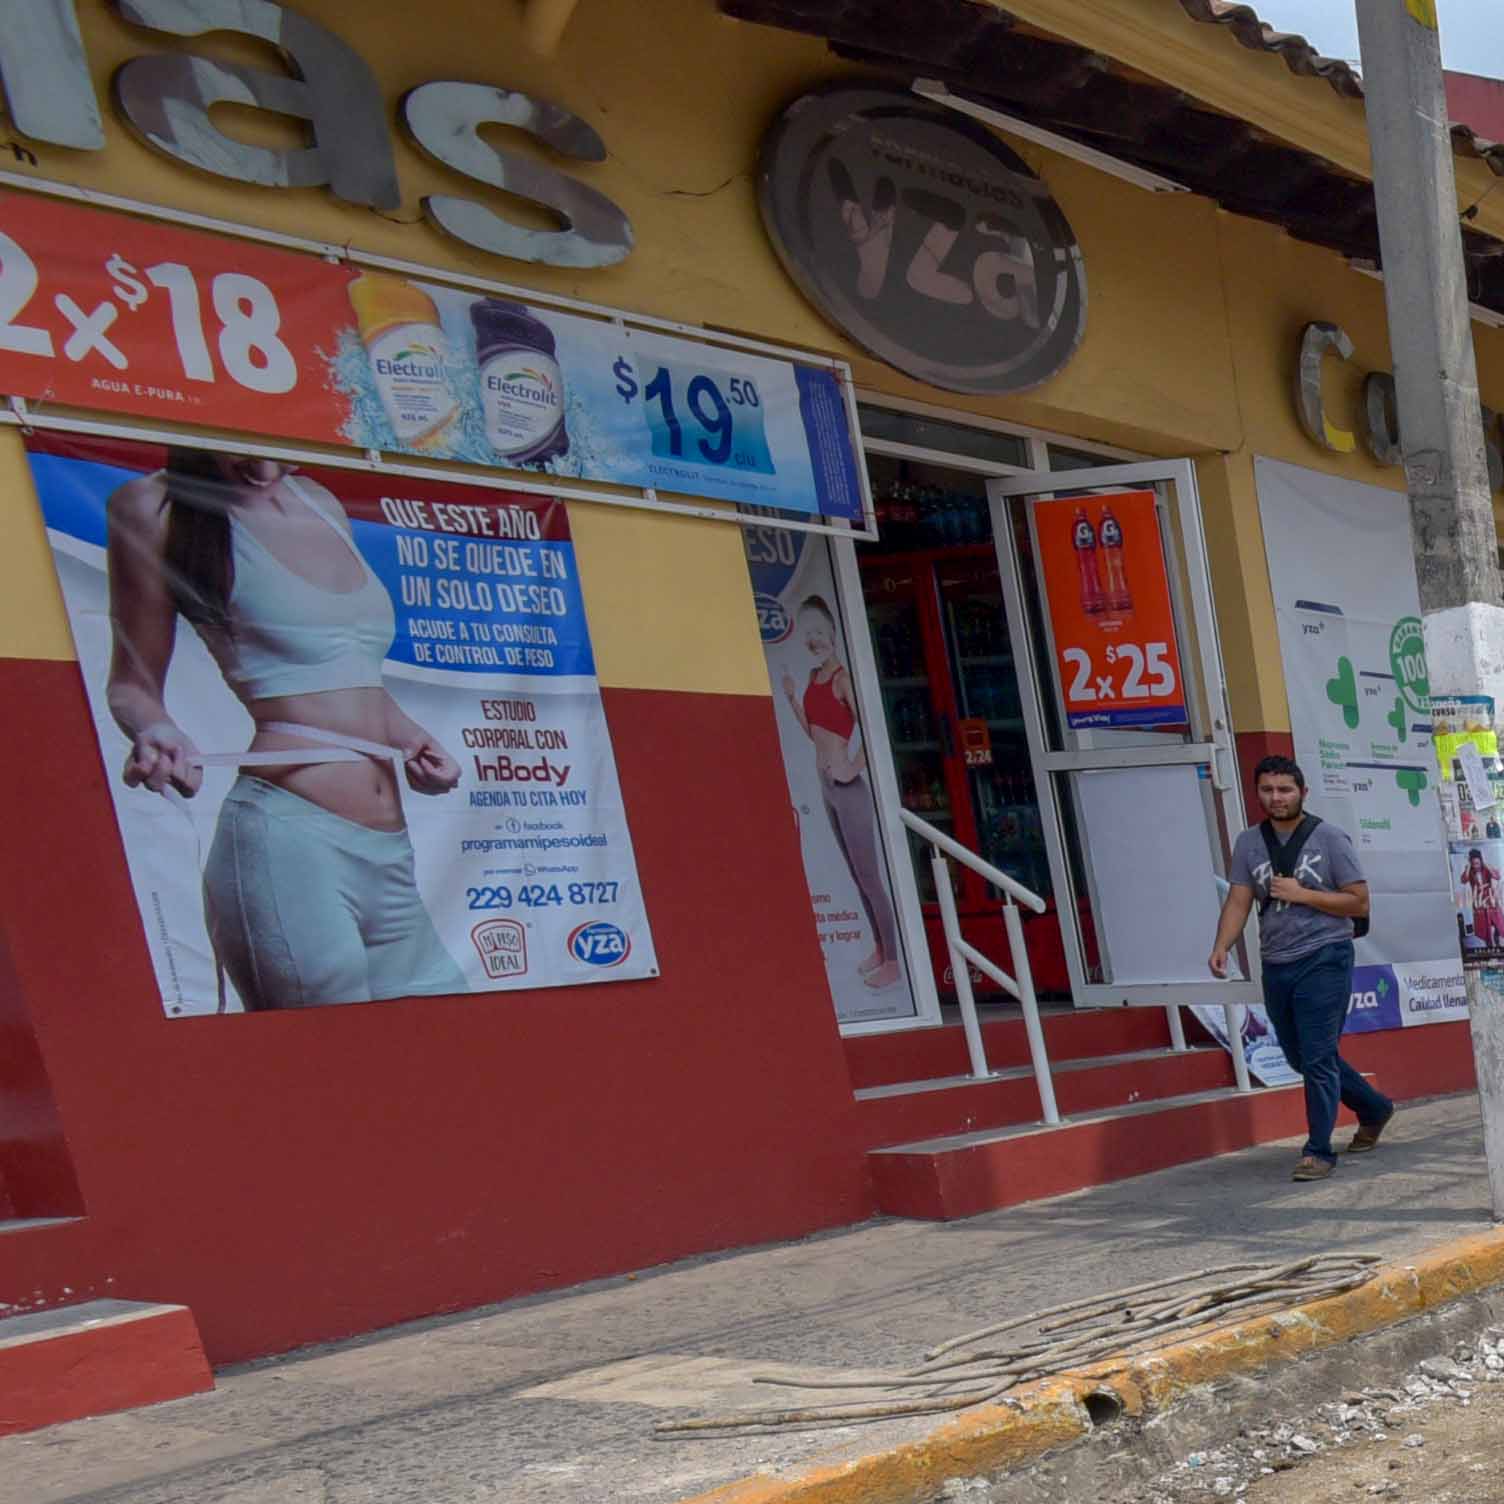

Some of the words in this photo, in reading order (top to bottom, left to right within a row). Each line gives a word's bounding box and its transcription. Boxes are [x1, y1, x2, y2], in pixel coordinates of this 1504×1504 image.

[91, 377, 130, 396] AGUA
[134, 383, 185, 403] E-PURA
[487, 375, 559, 407] Electrolit
[380, 497, 435, 530] QUE
[431, 502, 495, 536] ESTE
[498, 504, 541, 541] AÑO
[396, 535, 429, 568] NO
[433, 539, 462, 572] SE
[465, 543, 539, 578] QUEDE
[540, 550, 568, 580] EN
[401, 575, 432, 608] UN
[436, 578, 494, 612] SOLO
[496, 583, 567, 617] DESEO
[408, 617, 457, 641] ACUDE
[459, 621, 470, 641] A
[469, 622, 490, 642] TU
[493, 624, 558, 646] CONSULTA
[414, 642, 435, 664] DE
[436, 644, 505, 666] CONTROL
[506, 648, 524, 667] DE
[524, 649, 555, 668] PESO
[480, 699, 537, 722] ESTUDIO
[462, 727, 535, 750] CORPORAL
[535, 730, 569, 751] CON
[474, 754, 571, 787] InBody
[469, 791, 511, 808] AGENDA
[511, 791, 528, 807] TU
[529, 790, 558, 807] CITA
[559, 790, 587, 806] HOY
[461, 833, 608, 853] programamipesoideal
[466, 887, 513, 911] 229
[518, 884, 563, 908] 424
[568, 881, 619, 905] 8727
[577, 932, 624, 960] yza
[489, 956, 522, 973] IDEAL
